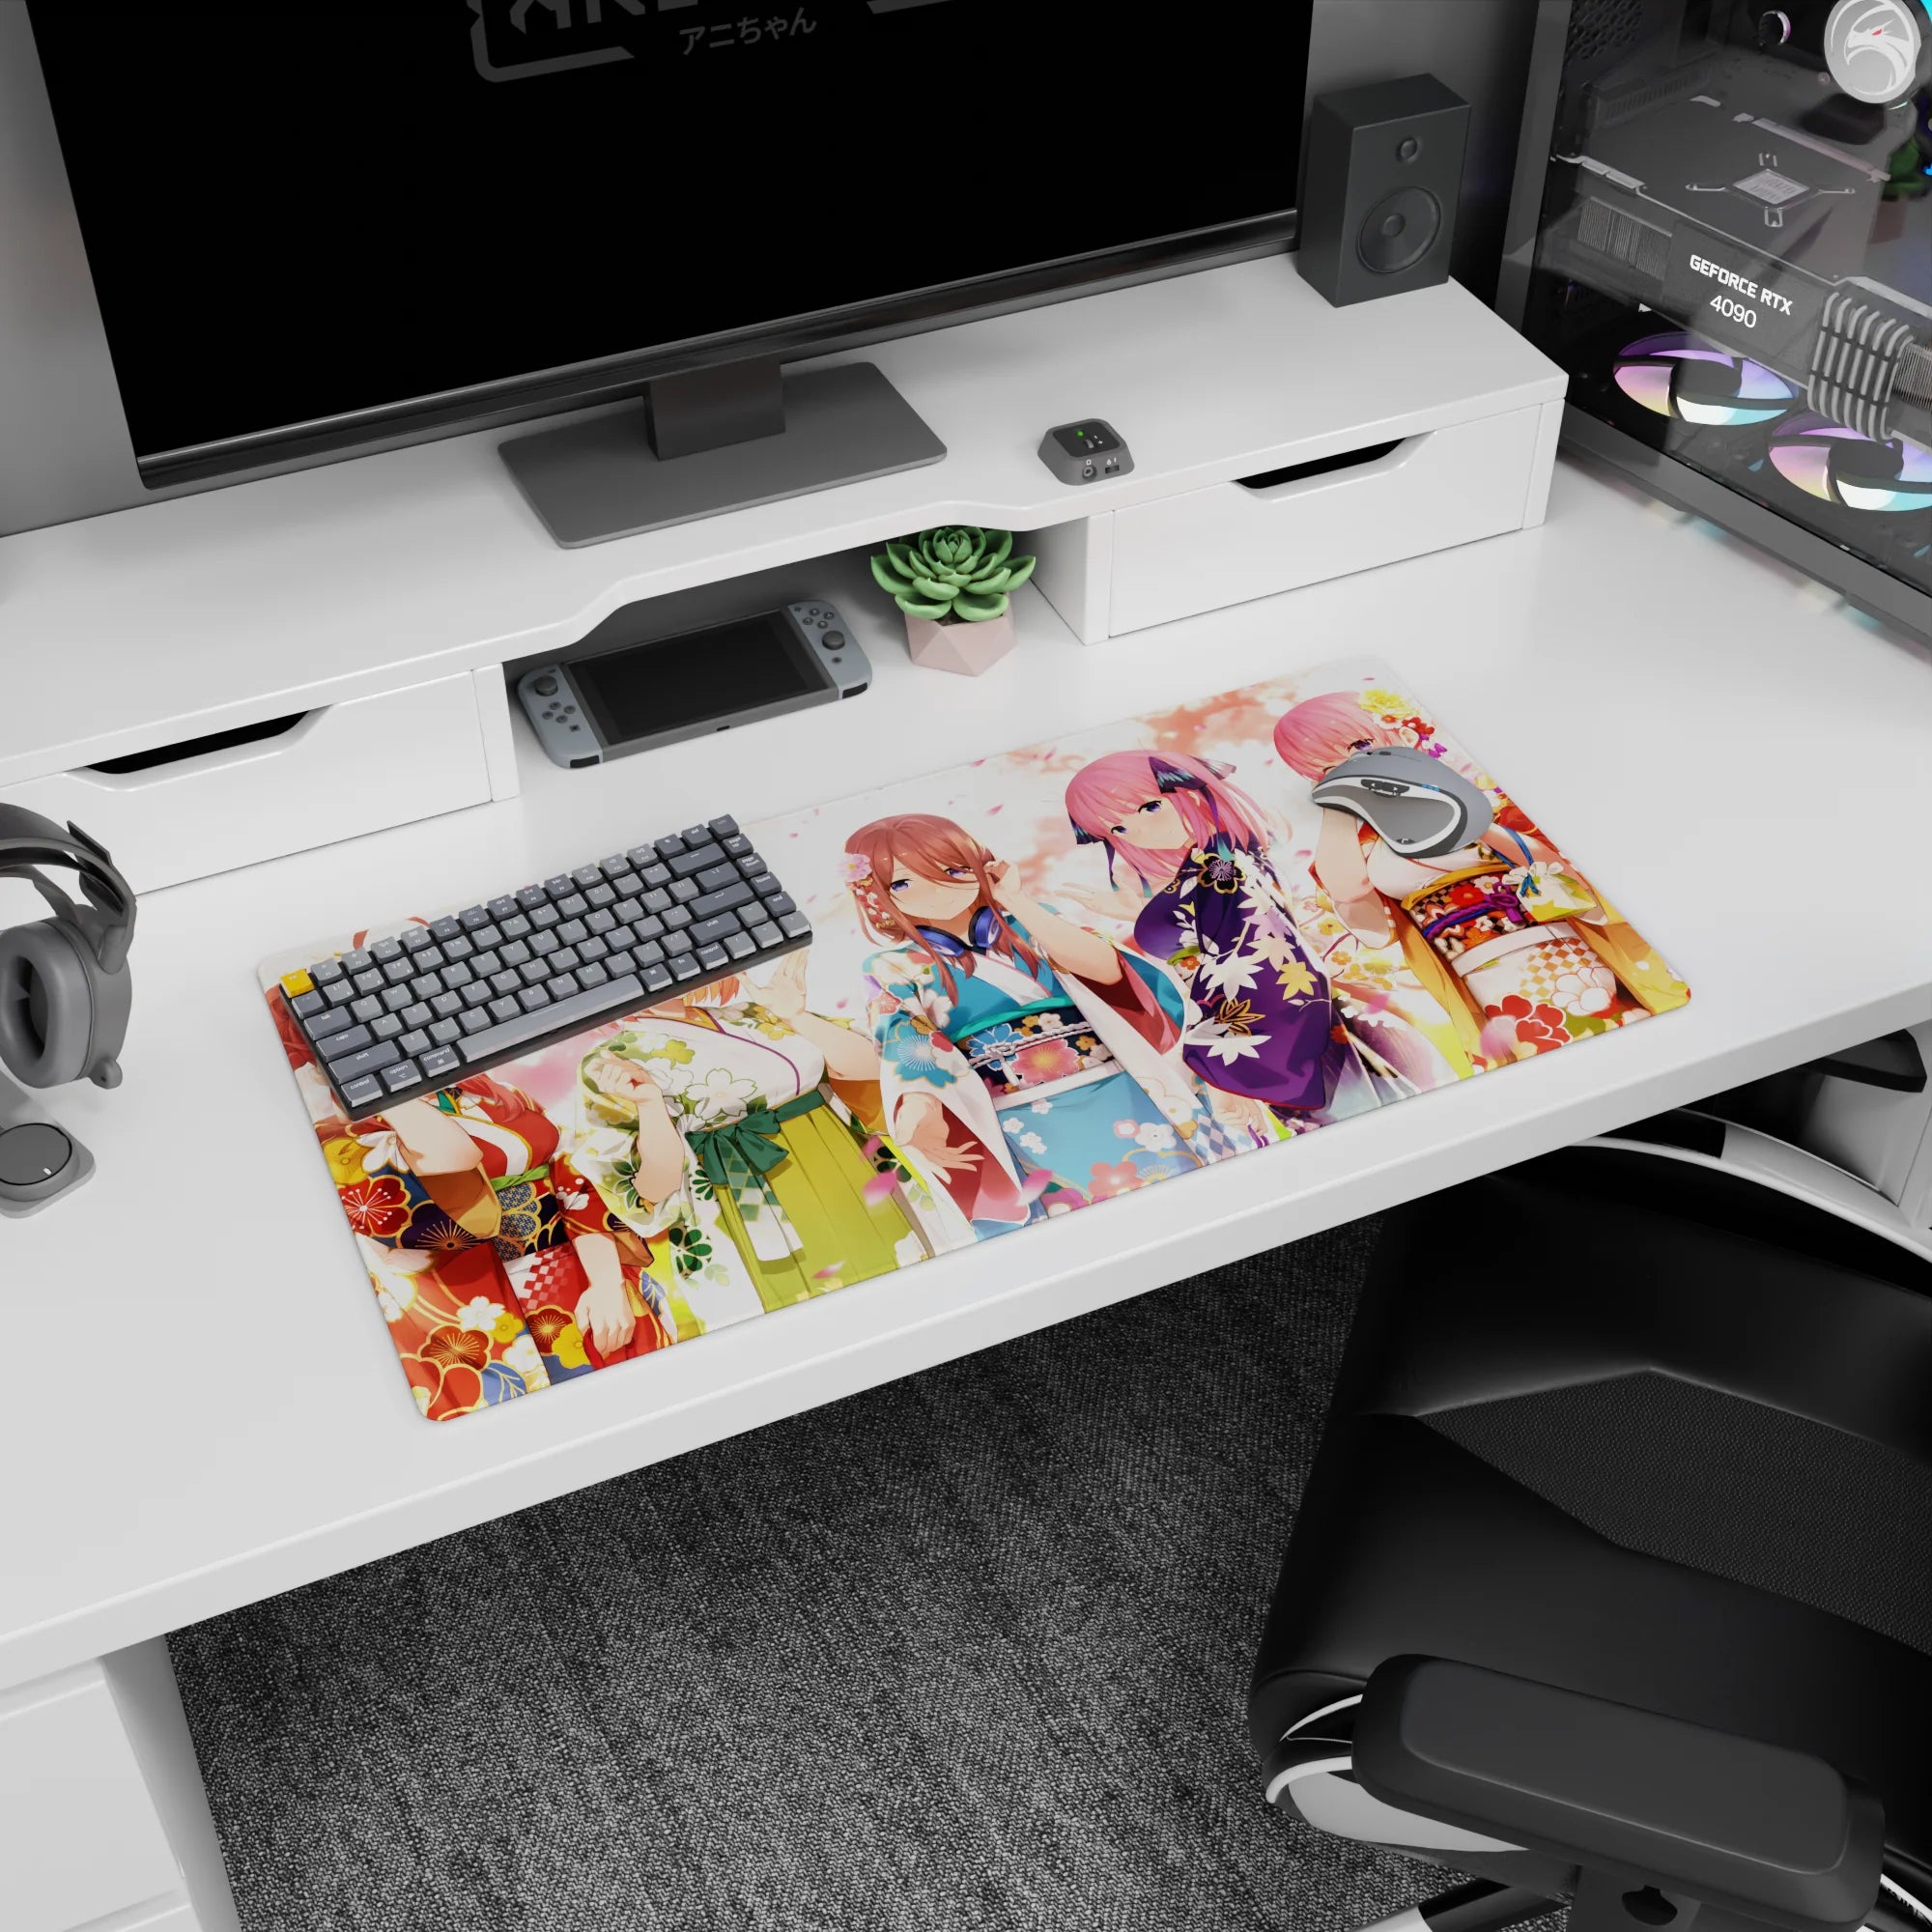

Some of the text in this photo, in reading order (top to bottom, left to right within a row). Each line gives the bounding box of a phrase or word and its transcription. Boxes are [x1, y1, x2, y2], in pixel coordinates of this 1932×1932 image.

[678, 7, 817, 56] アニちゃん
[1690, 254, 1793, 316] GEFORCE RTX
[1709, 295, 1757, 328] 4090
[423, 1047, 451, 1062] command
[389, 1065, 409, 1074] option
[350, 1079, 370, 1090] control
